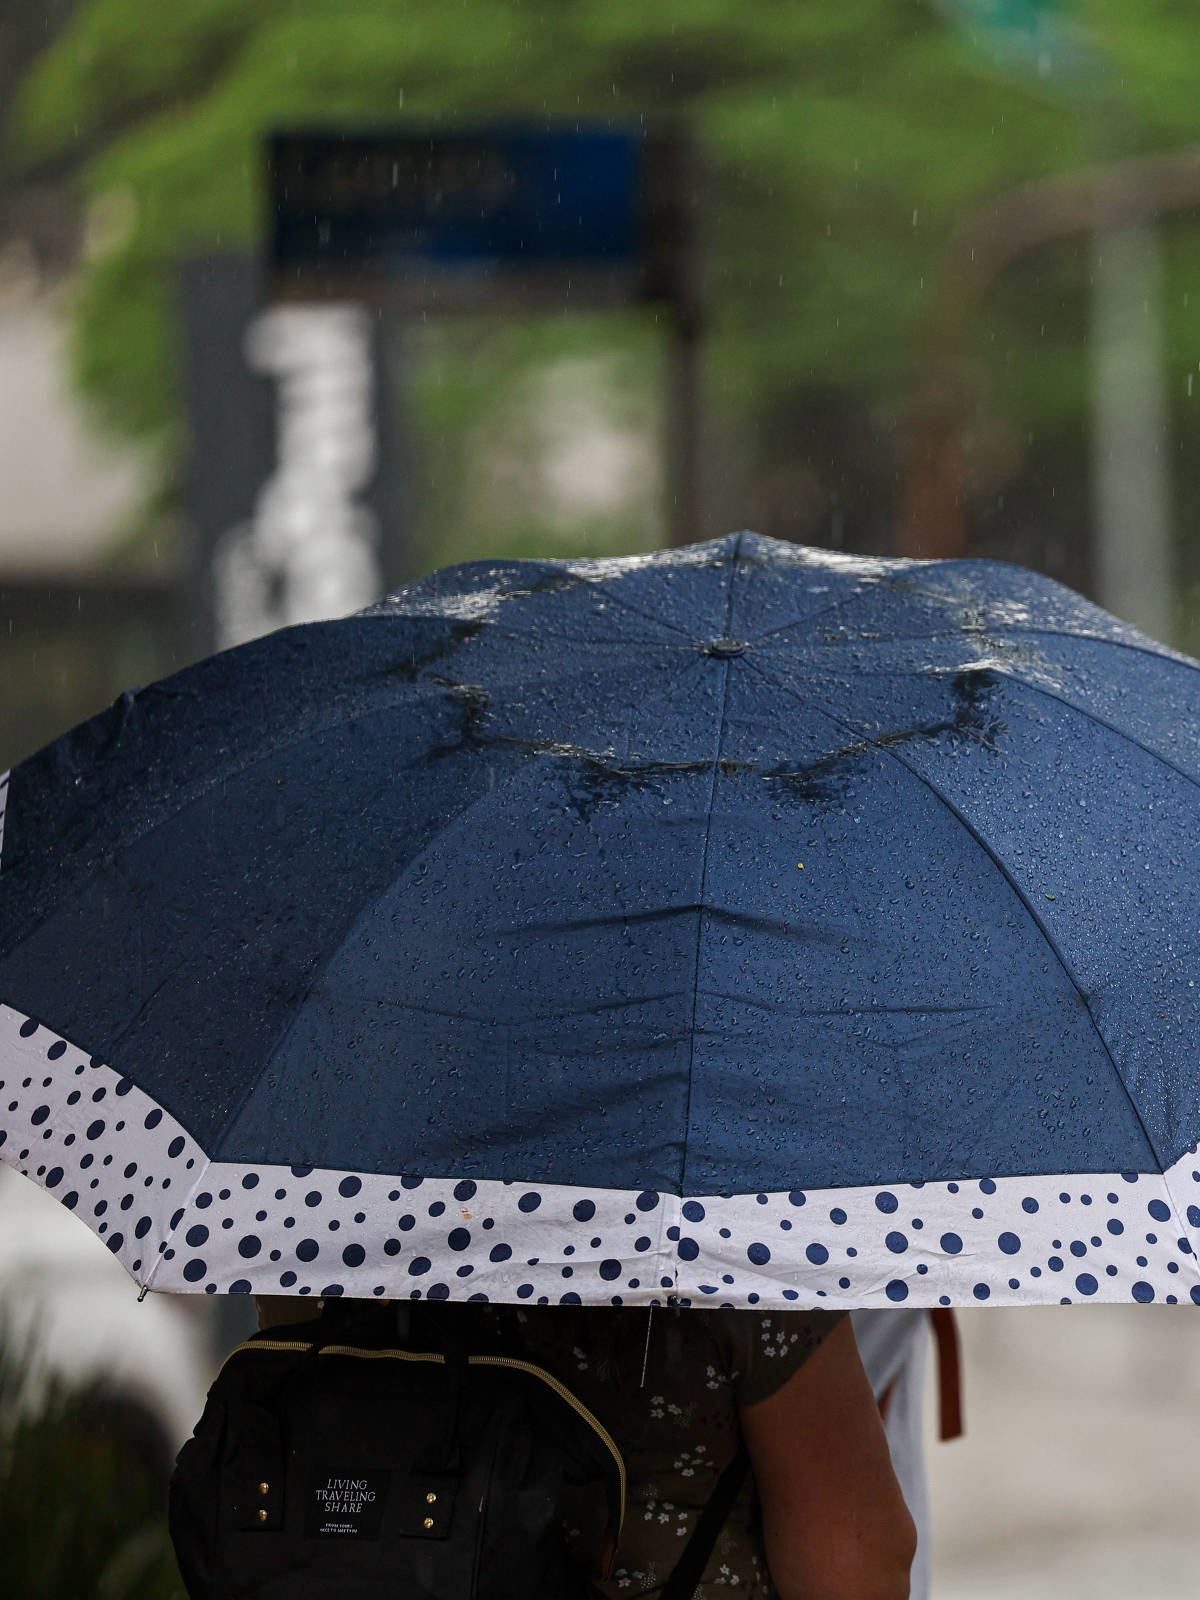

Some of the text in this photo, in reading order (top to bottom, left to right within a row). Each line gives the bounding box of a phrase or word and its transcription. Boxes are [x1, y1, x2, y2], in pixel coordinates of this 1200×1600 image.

[327, 1479, 368, 1490] LIVING
[315, 1489, 376, 1502] TRAVELING
[324, 1501, 363, 1513] SHARE
